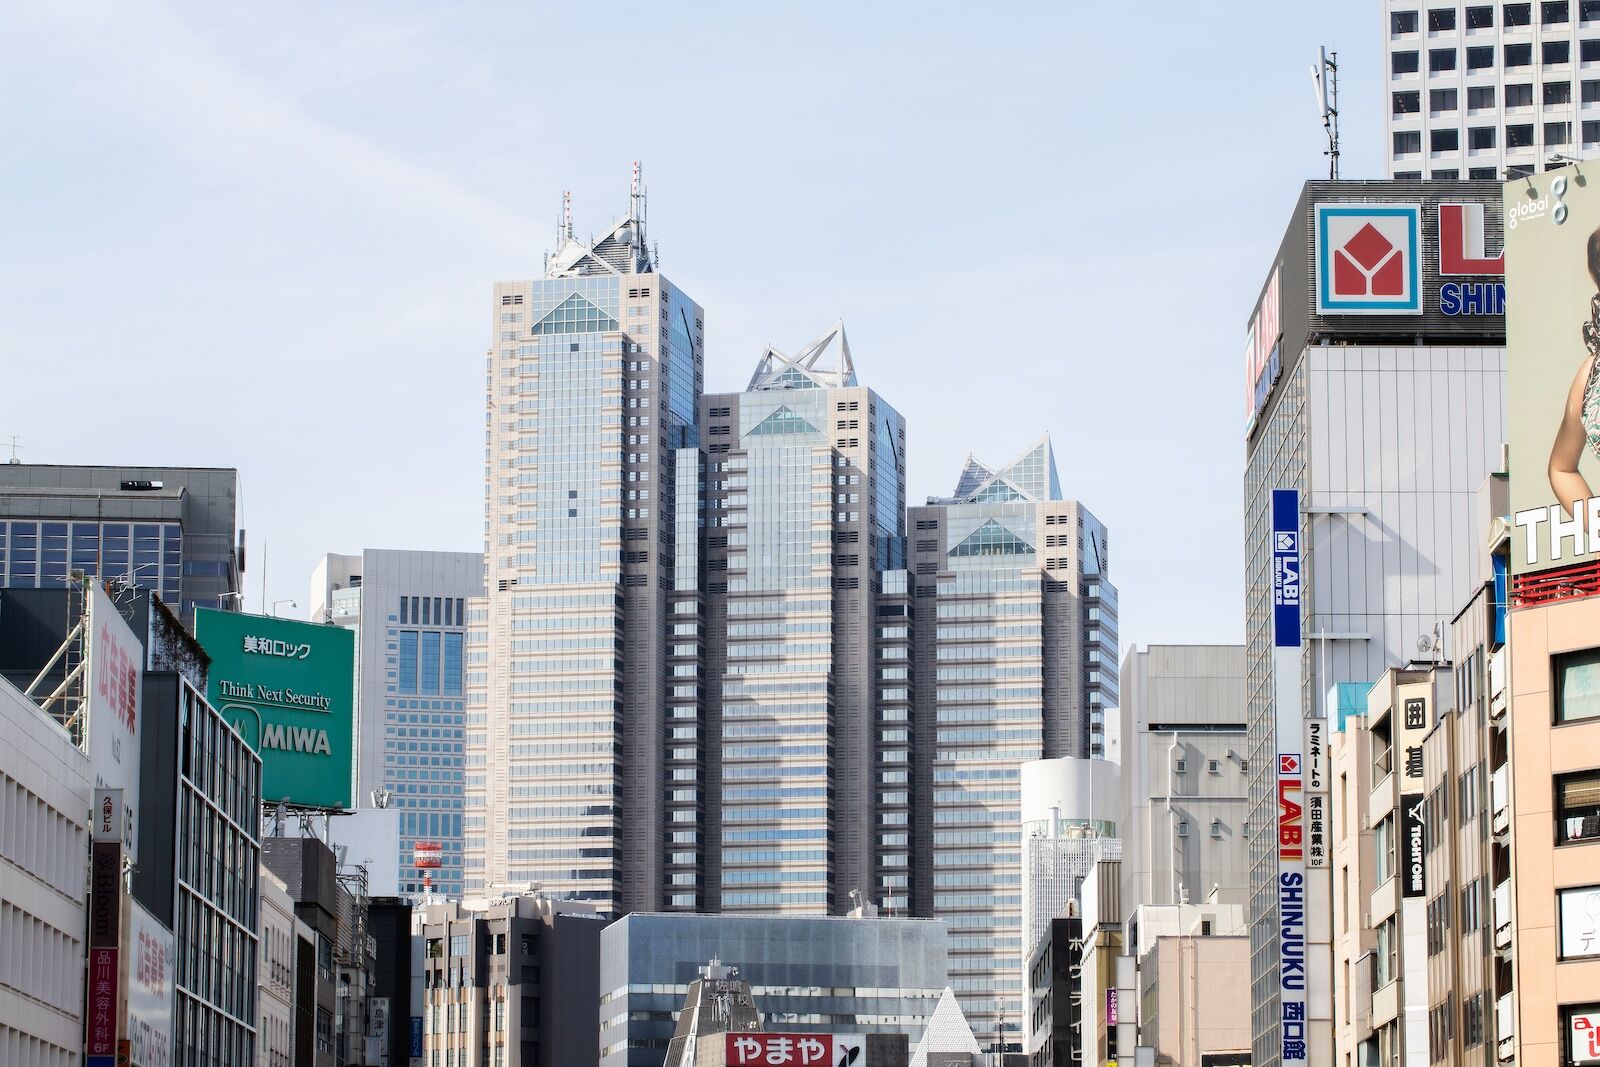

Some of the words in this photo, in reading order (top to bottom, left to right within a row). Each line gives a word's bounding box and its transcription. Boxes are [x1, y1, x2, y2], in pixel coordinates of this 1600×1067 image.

[1509, 194, 1549, 230] global
[1438, 203, 1506, 276] L
[1275, 556, 1283, 588] SHINJUKU
[1282, 556, 1299, 606] LABI
[243, 635, 311, 660] 美和ロック
[219, 680, 254, 698] Think
[257, 684, 283, 702] Next
[285, 688, 331, 710] Security
[262, 722, 332, 756] MIWA
[1309, 723, 1321, 788] ラミネートの
[102, 796, 113, 833] 久保ビル
[1279, 779, 1303, 862] LABI
[1311, 859, 1323, 867] 10F
[97, 874, 115, 937] Bloom
[1280, 872, 1305, 991] SHINJUKU
[95, 950, 112, 1042] 品川美容外科
[94, 1042, 110, 1053] 6F
[1282, 1001, 1306, 1061] 西口館
[733, 1036, 826, 1066] やまや
